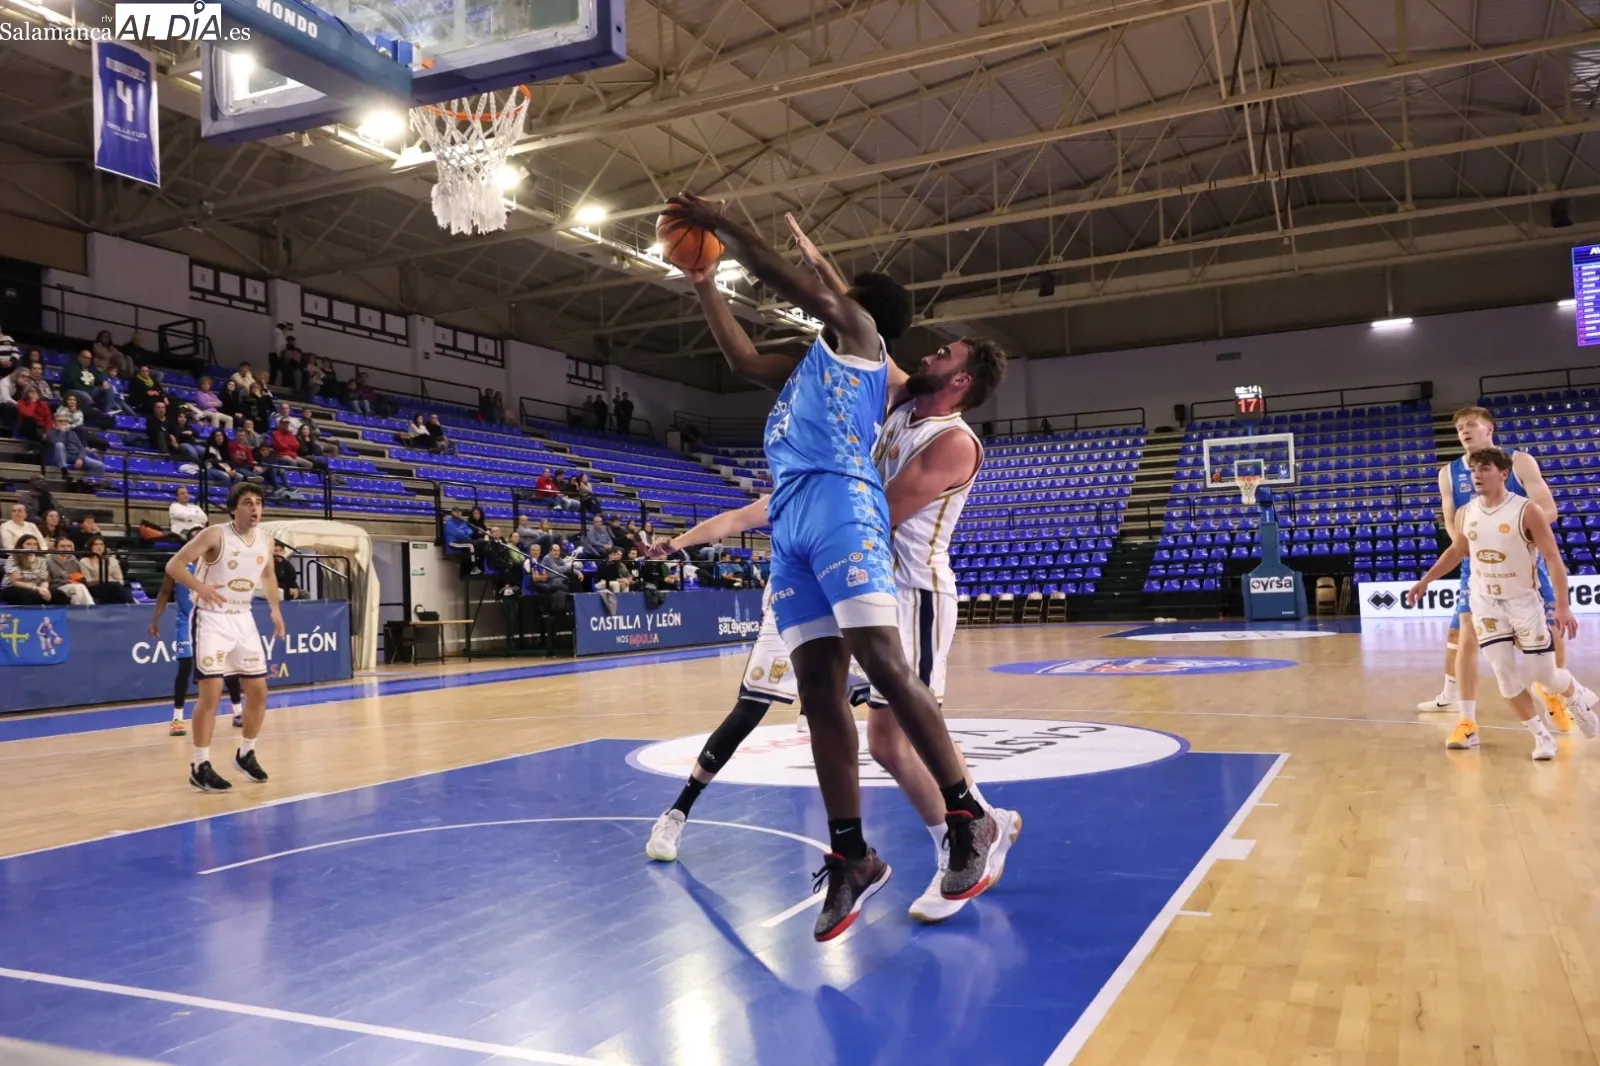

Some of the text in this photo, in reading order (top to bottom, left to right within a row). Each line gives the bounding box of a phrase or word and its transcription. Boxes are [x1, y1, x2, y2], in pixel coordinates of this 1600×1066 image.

[257, 0, 318, 38] MONDO
[116, 79, 133, 122] 4
[1400, 588, 1461, 610] erre
[1486, 584, 1502, 595] 13
[590, 608, 681, 631] CASTILLA Y LEÓN
[285, 625, 337, 654] LEÓN
